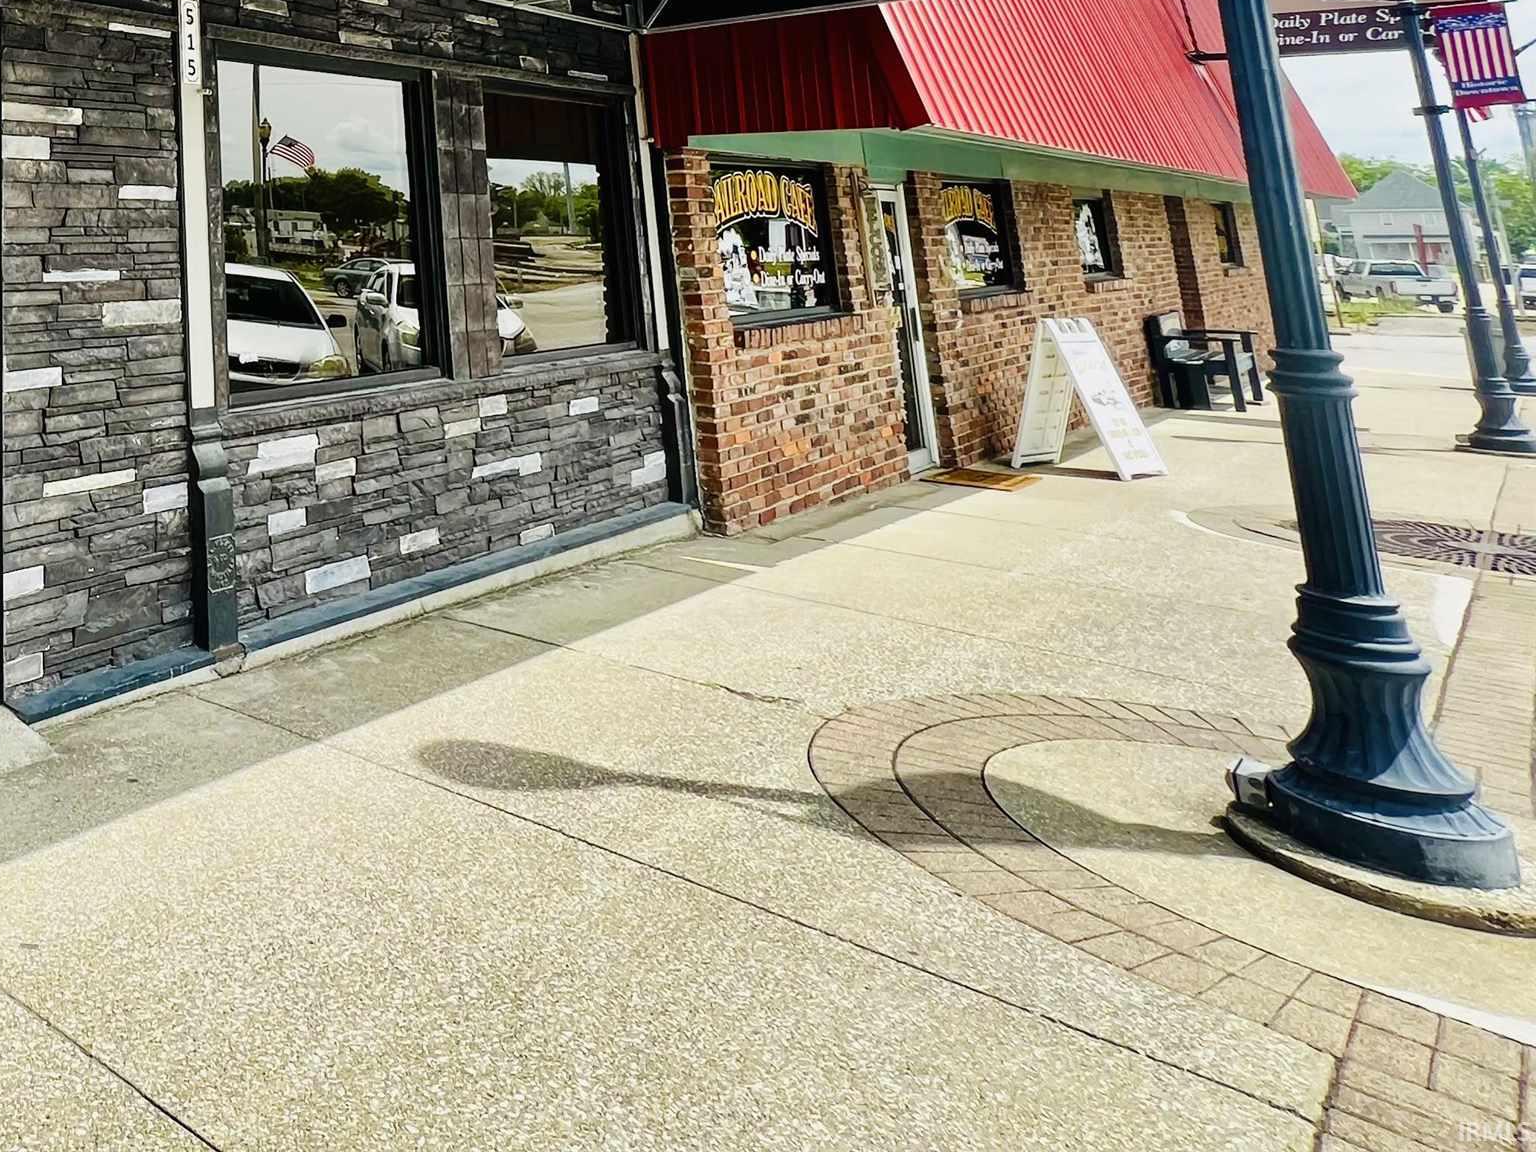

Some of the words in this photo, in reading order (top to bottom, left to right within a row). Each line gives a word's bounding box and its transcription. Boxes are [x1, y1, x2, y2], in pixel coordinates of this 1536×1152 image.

[1319, 11, 1367, 26] Plate
[185, 8, 197, 76] 515
[1276, 30, 1331, 46] ine-In
[1338, 32, 1360, 43] or
[714, 170, 781, 231] AILROAD
